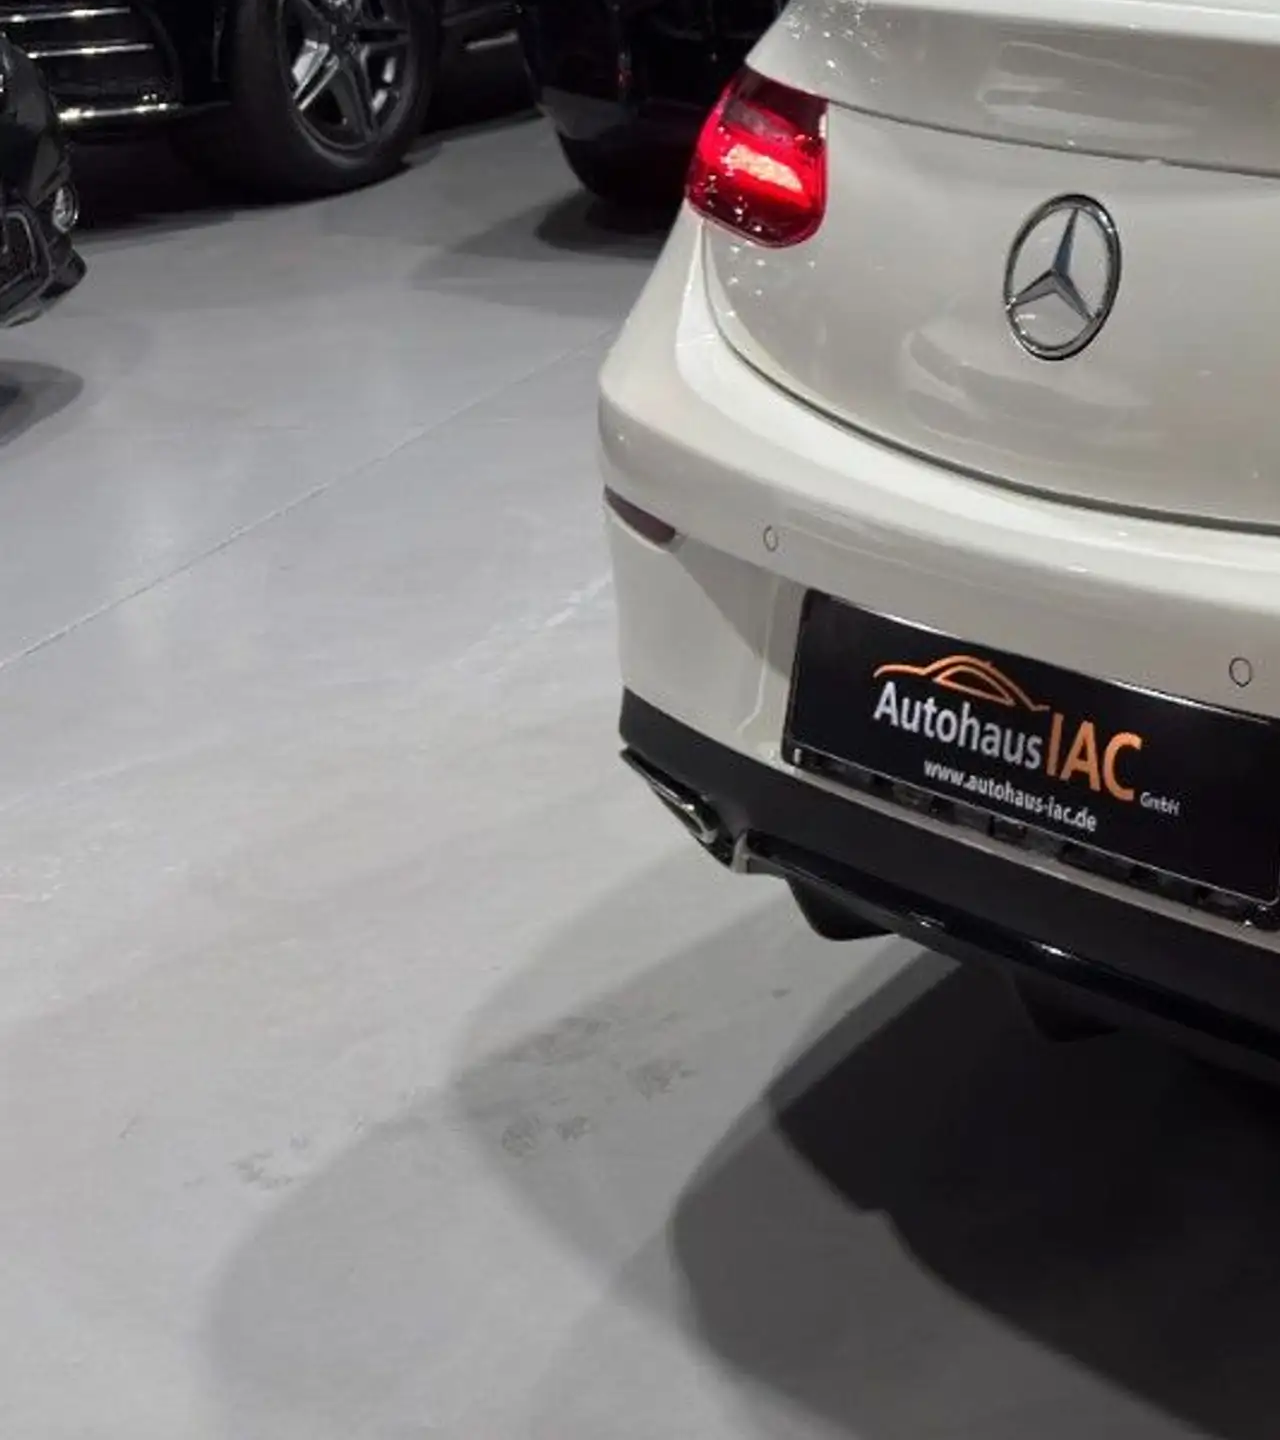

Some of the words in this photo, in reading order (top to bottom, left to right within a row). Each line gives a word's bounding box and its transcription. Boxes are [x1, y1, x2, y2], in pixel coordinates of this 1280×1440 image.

[873, 680, 1043, 770] Autohaus
[1045, 712, 1142, 801] IAC
[1140, 791, 1180, 816] GmbH
[923, 759, 1097, 832] www.autohaus-iac.de
